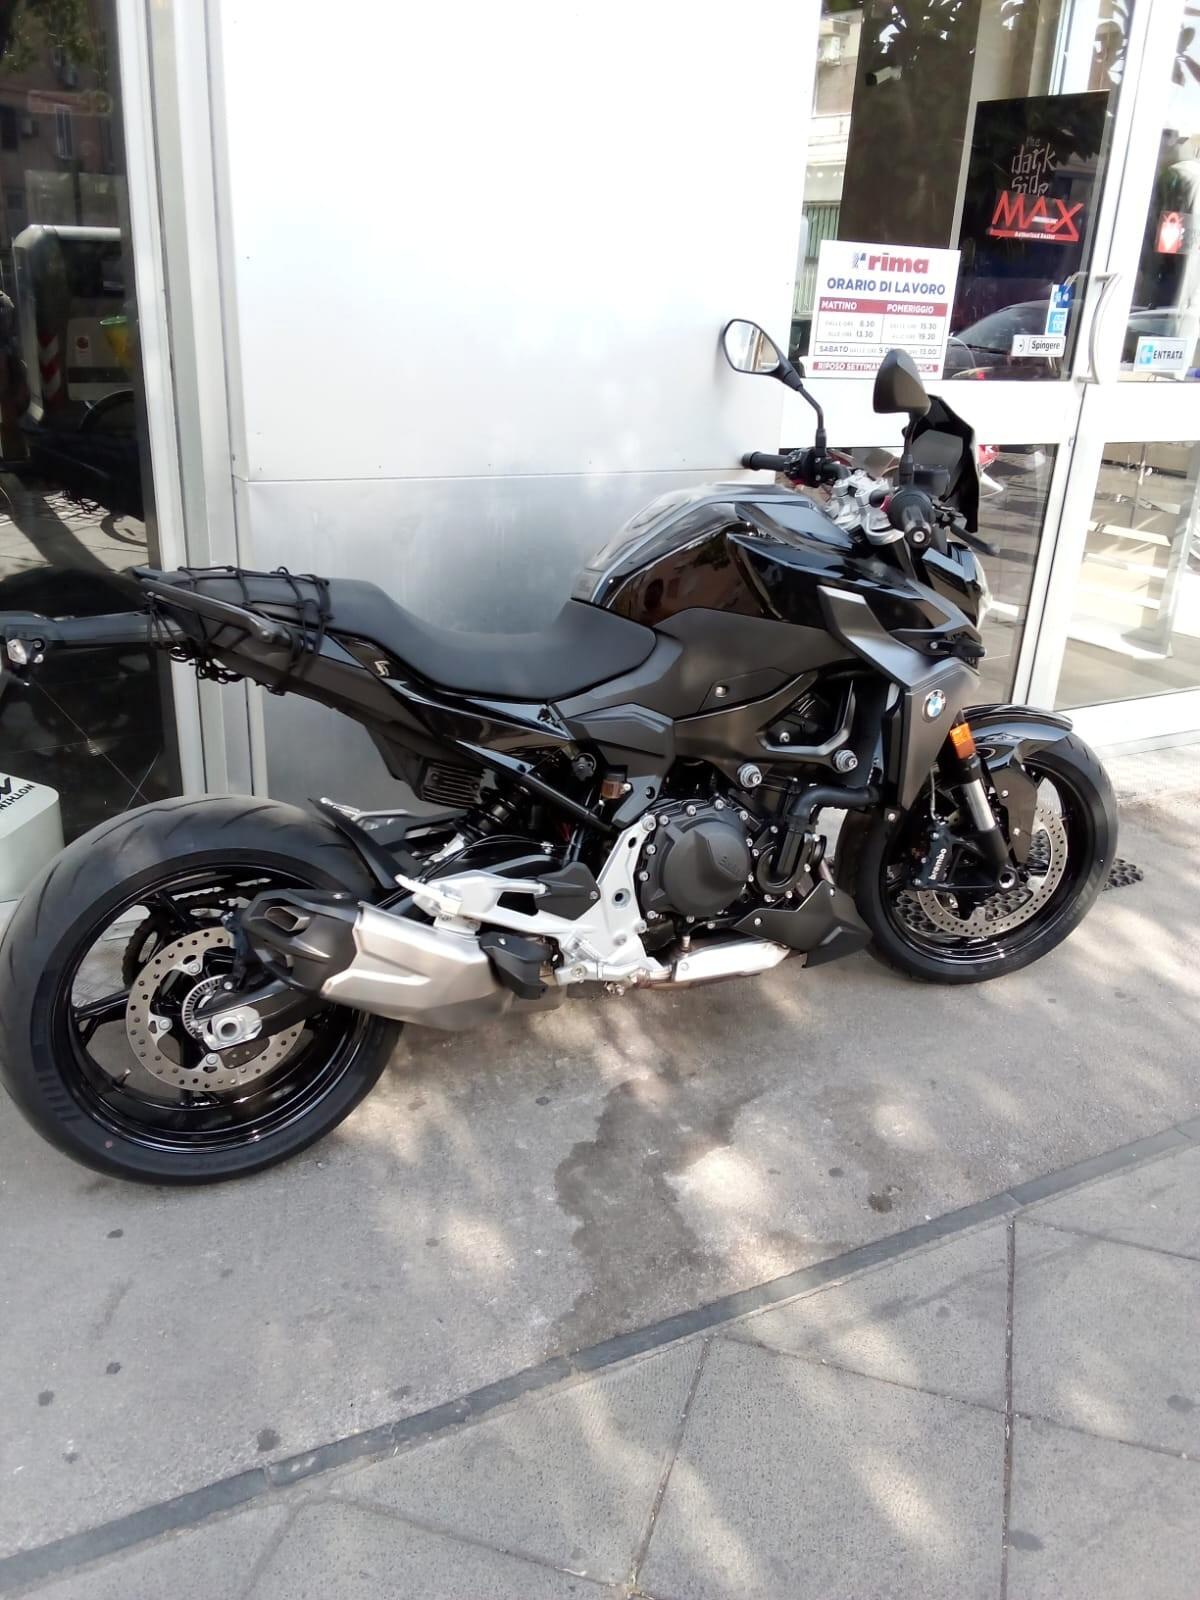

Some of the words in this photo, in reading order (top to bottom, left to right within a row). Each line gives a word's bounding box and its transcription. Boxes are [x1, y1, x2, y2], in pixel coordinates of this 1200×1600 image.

[1011, 142, 1057, 174] dark
[992, 190, 1085, 237] MAX
[827, 277, 877, 292] ORARIO
[879, 280, 892, 293] DI
[894, 281, 946, 296] LAVORO
[821, 300, 858, 311] MATTINO
[886, 303, 935, 314] POMERIGGIO
[819, 345, 849, 353] SABATO
[1031, 339, 1061, 352] Spingere
[1152, 350, 1184, 360] ENTRATA
[928, 848, 948, 881] brembo
